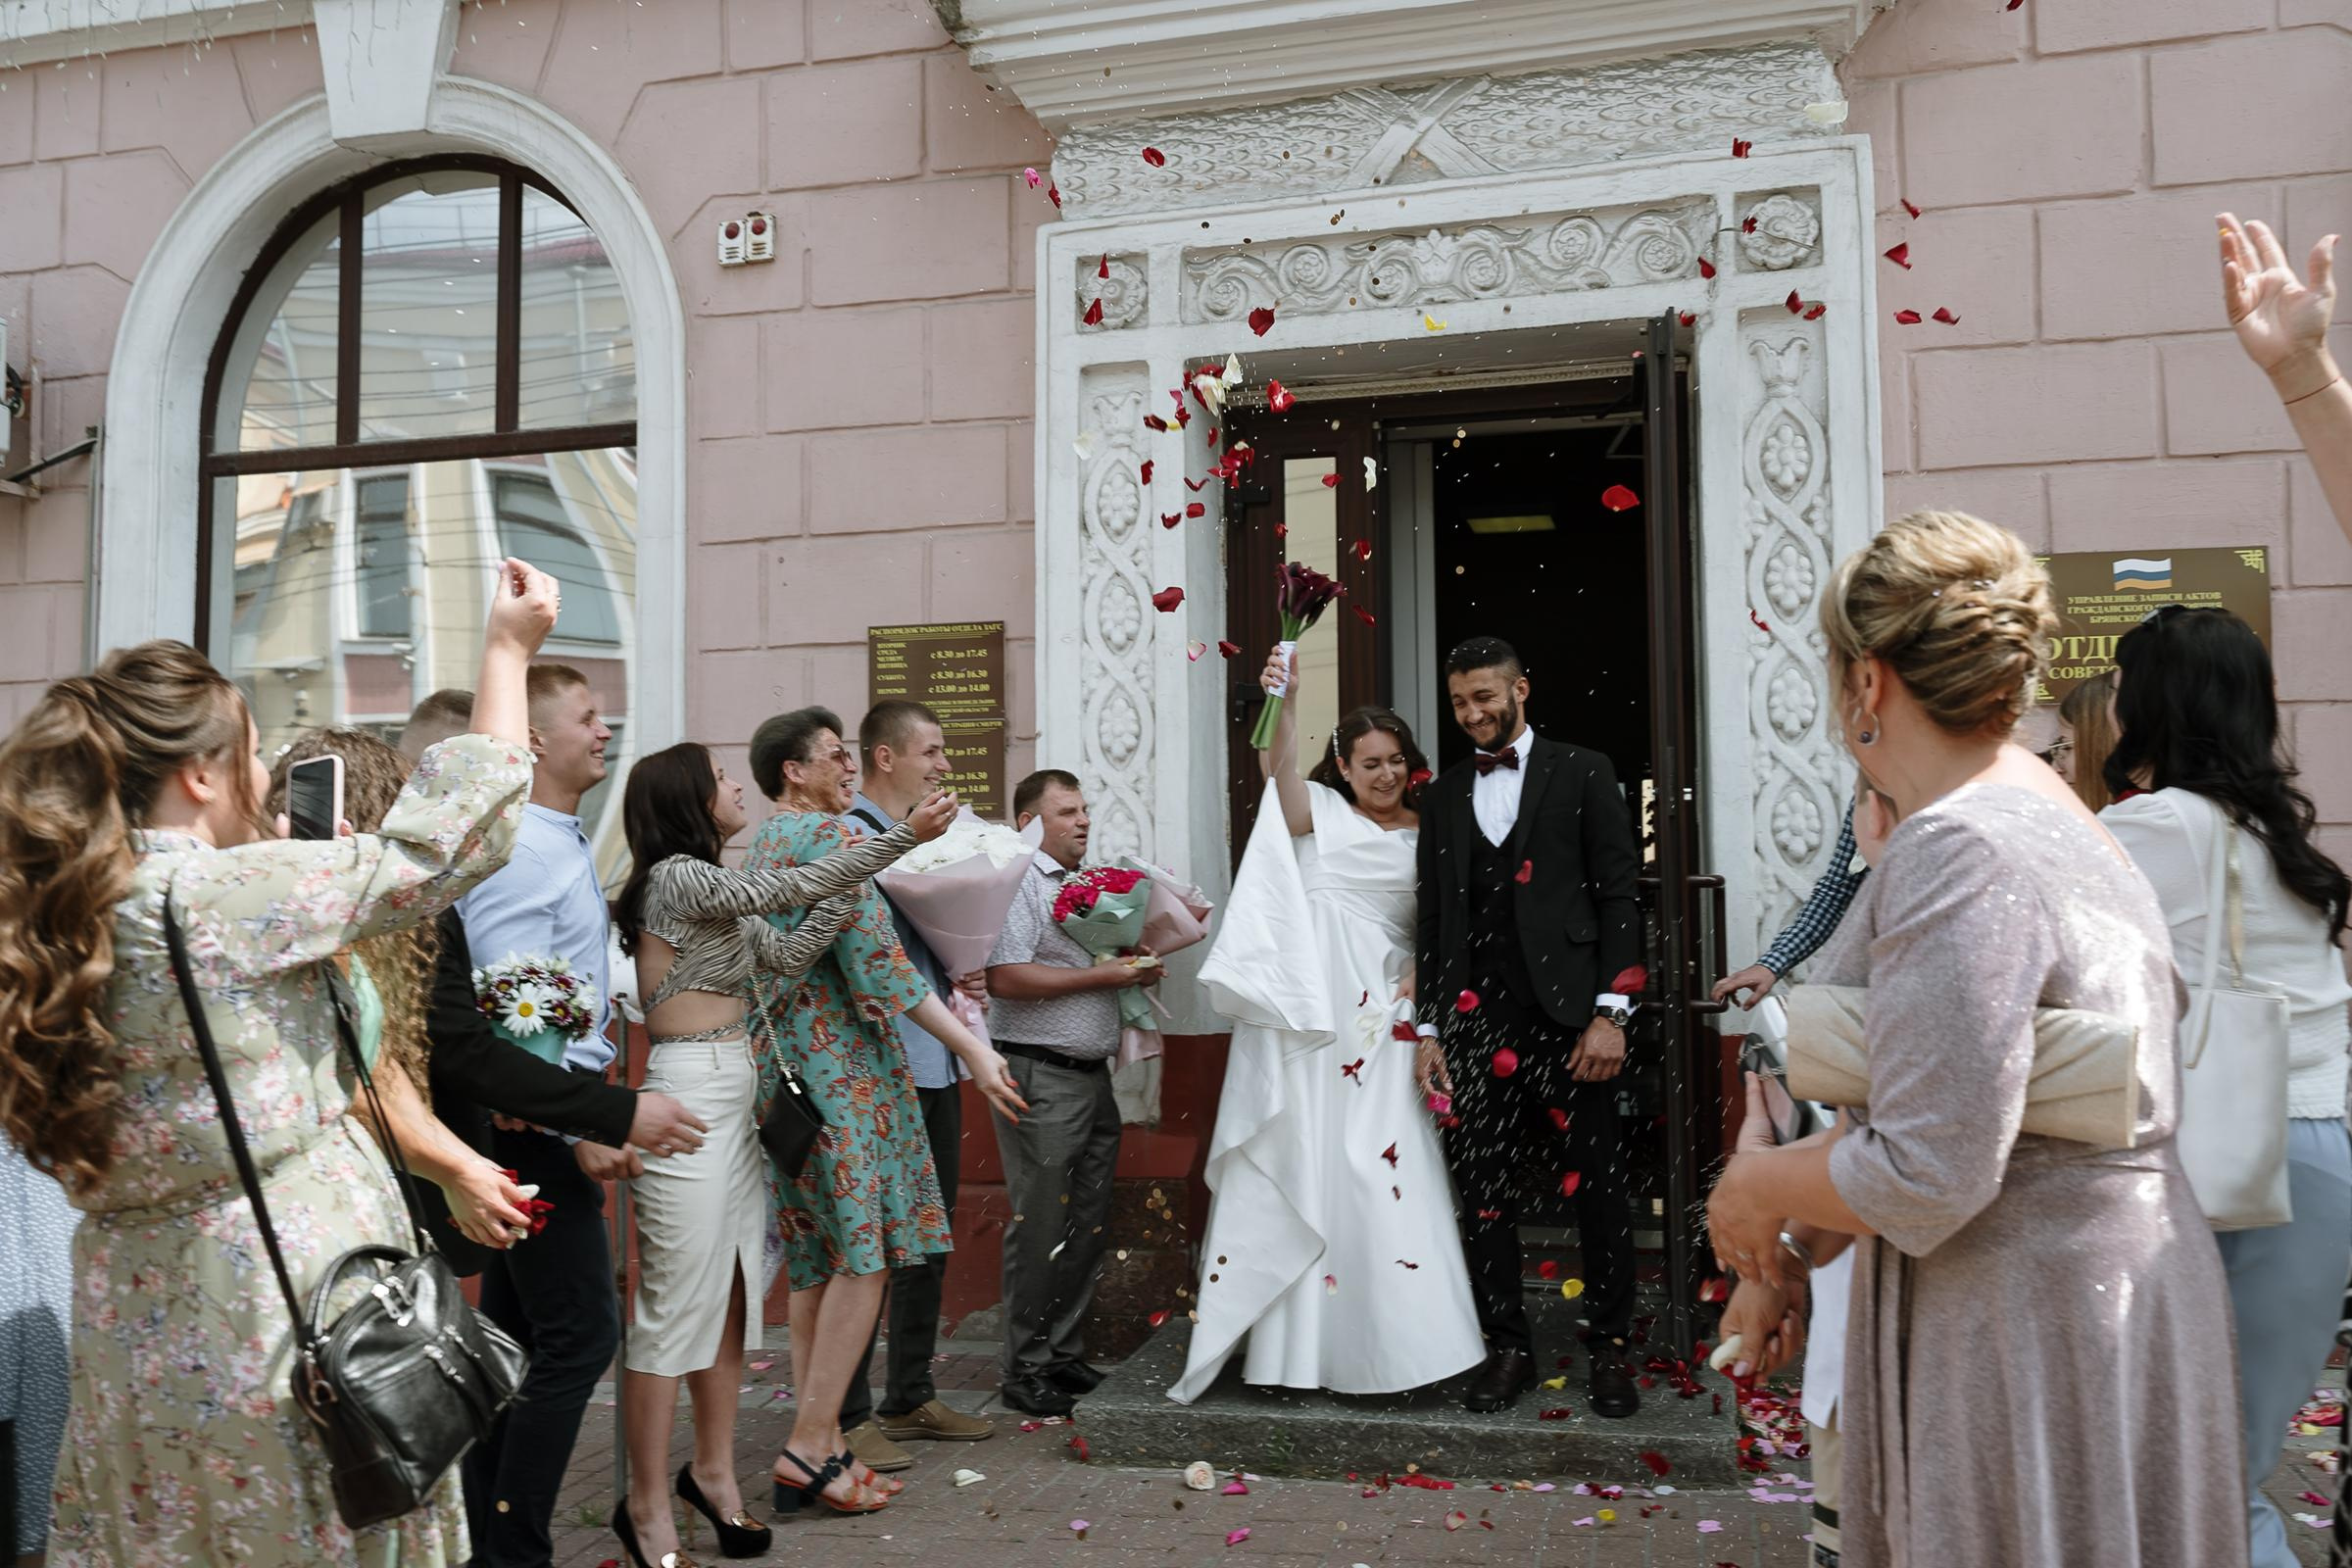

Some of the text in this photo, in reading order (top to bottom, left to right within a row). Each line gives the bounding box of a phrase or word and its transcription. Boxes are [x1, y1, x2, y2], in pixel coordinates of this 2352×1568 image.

[2068, 592, 2222, 604] УПРАВЛЕНИЕ ЗАПИСИ АКТОВ
[2067, 605, 2153, 614] ГРАЖДАНСКОГО
[2089, 613, 2145, 623] БРЯНСКО
[966, 649, 988, 658] 17.45
[966, 747, 988, 756] 17.45
